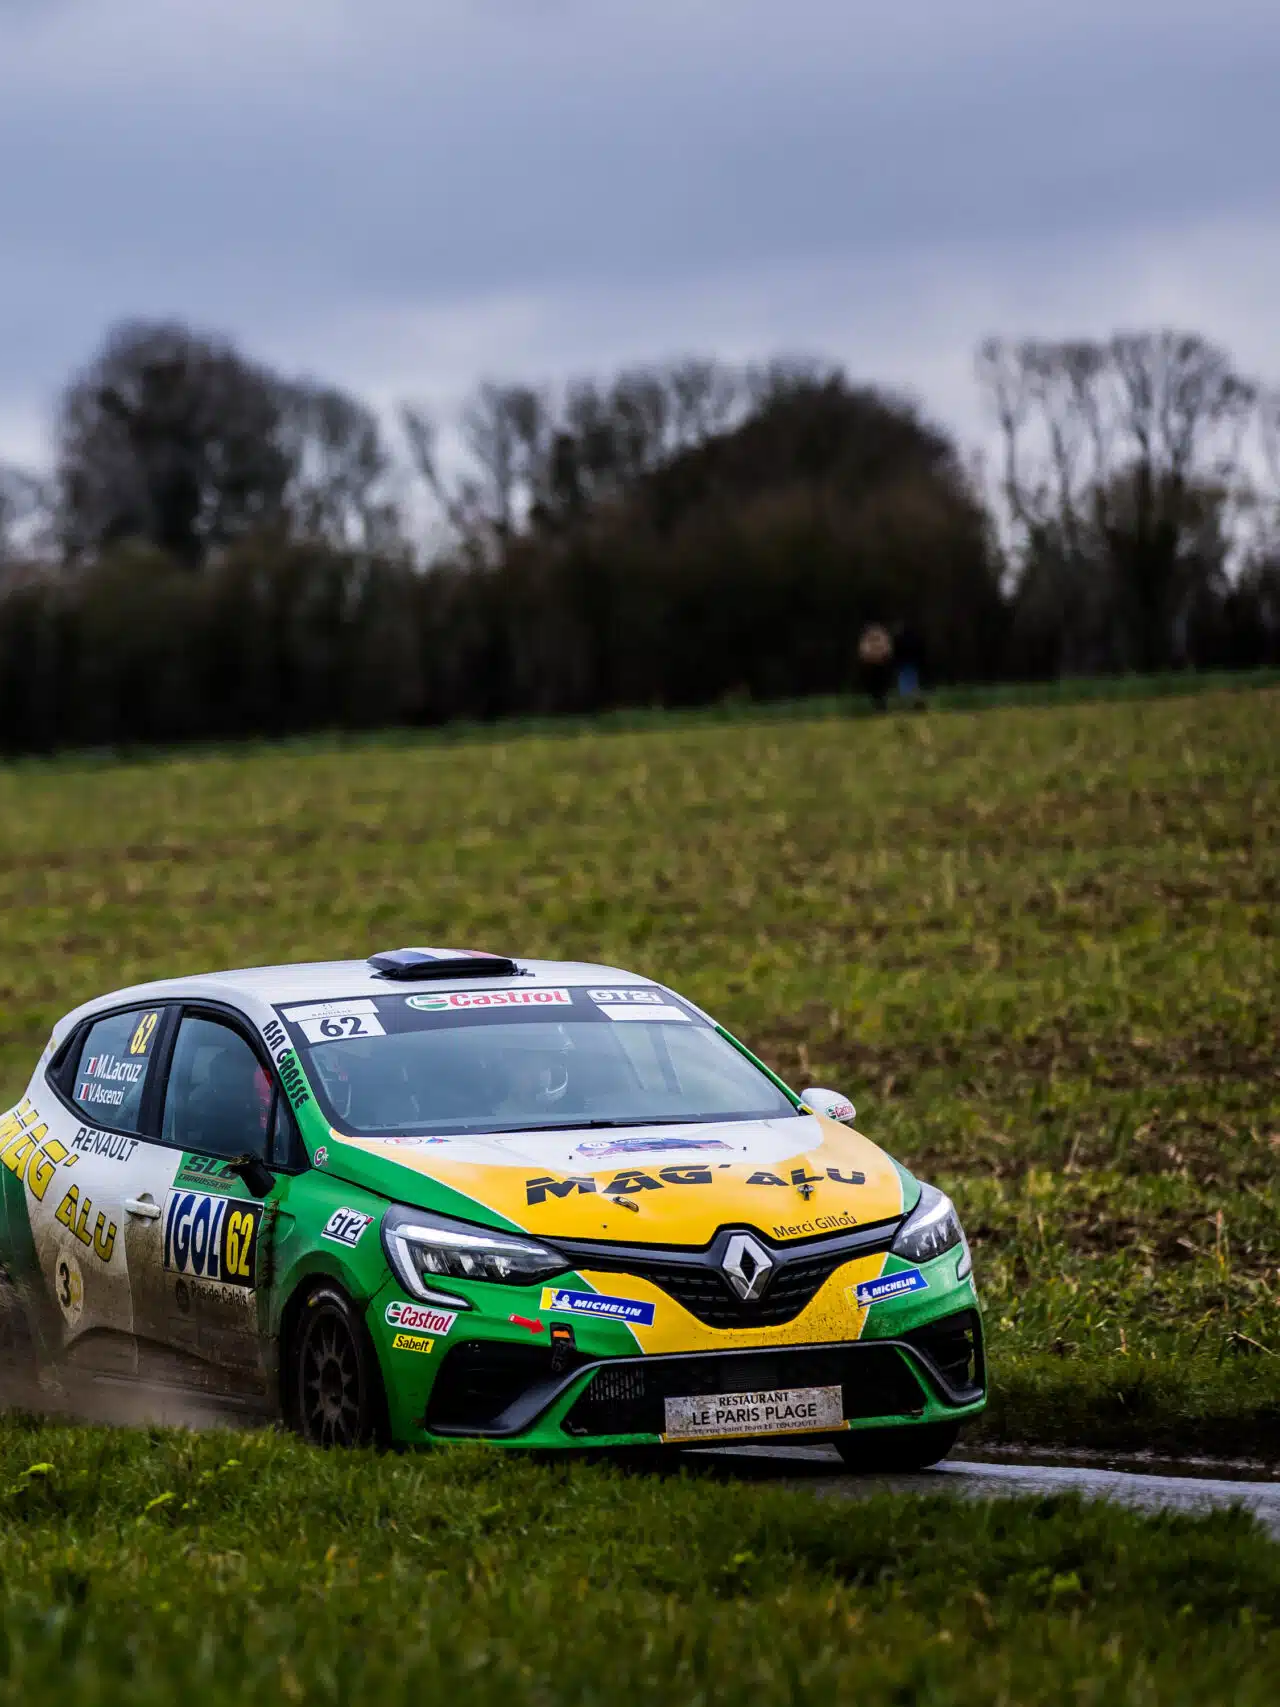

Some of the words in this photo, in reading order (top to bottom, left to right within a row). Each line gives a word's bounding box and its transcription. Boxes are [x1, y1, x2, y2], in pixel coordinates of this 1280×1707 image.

[450, 990, 569, 1006] Castrol
[130, 1013, 157, 1055] 62
[320, 1017, 368, 1037] 62
[94, 1054, 142, 1083] M.Lacruz
[262, 1020, 286, 1051] ASA
[277, 1048, 309, 1109] GRASSE
[88, 1083, 125, 1105] V.Ascenzi
[71, 1127, 139, 1162] RENAULT
[746, 1168, 865, 1187] ALU
[55, 1184, 117, 1262] ALU
[772, 1219, 813, 1239] Merci
[814, 1213, 858, 1231] Gillou
[164, 1192, 225, 1278] IGOL
[226, 1210, 253, 1277] 62
[872, 1276, 917, 1296] MICHELIN
[400, 1303, 454, 1332] Castrol
[574, 1299, 642, 1317] MICHELIN
[396, 1335, 430, 1352] Sabelt
[719, 1392, 789, 1406] RESTAURANT
[692, 1411, 710, 1425] LE
[716, 1408, 760, 1424] PARIS
[765, 1403, 817, 1420] PLAGE
